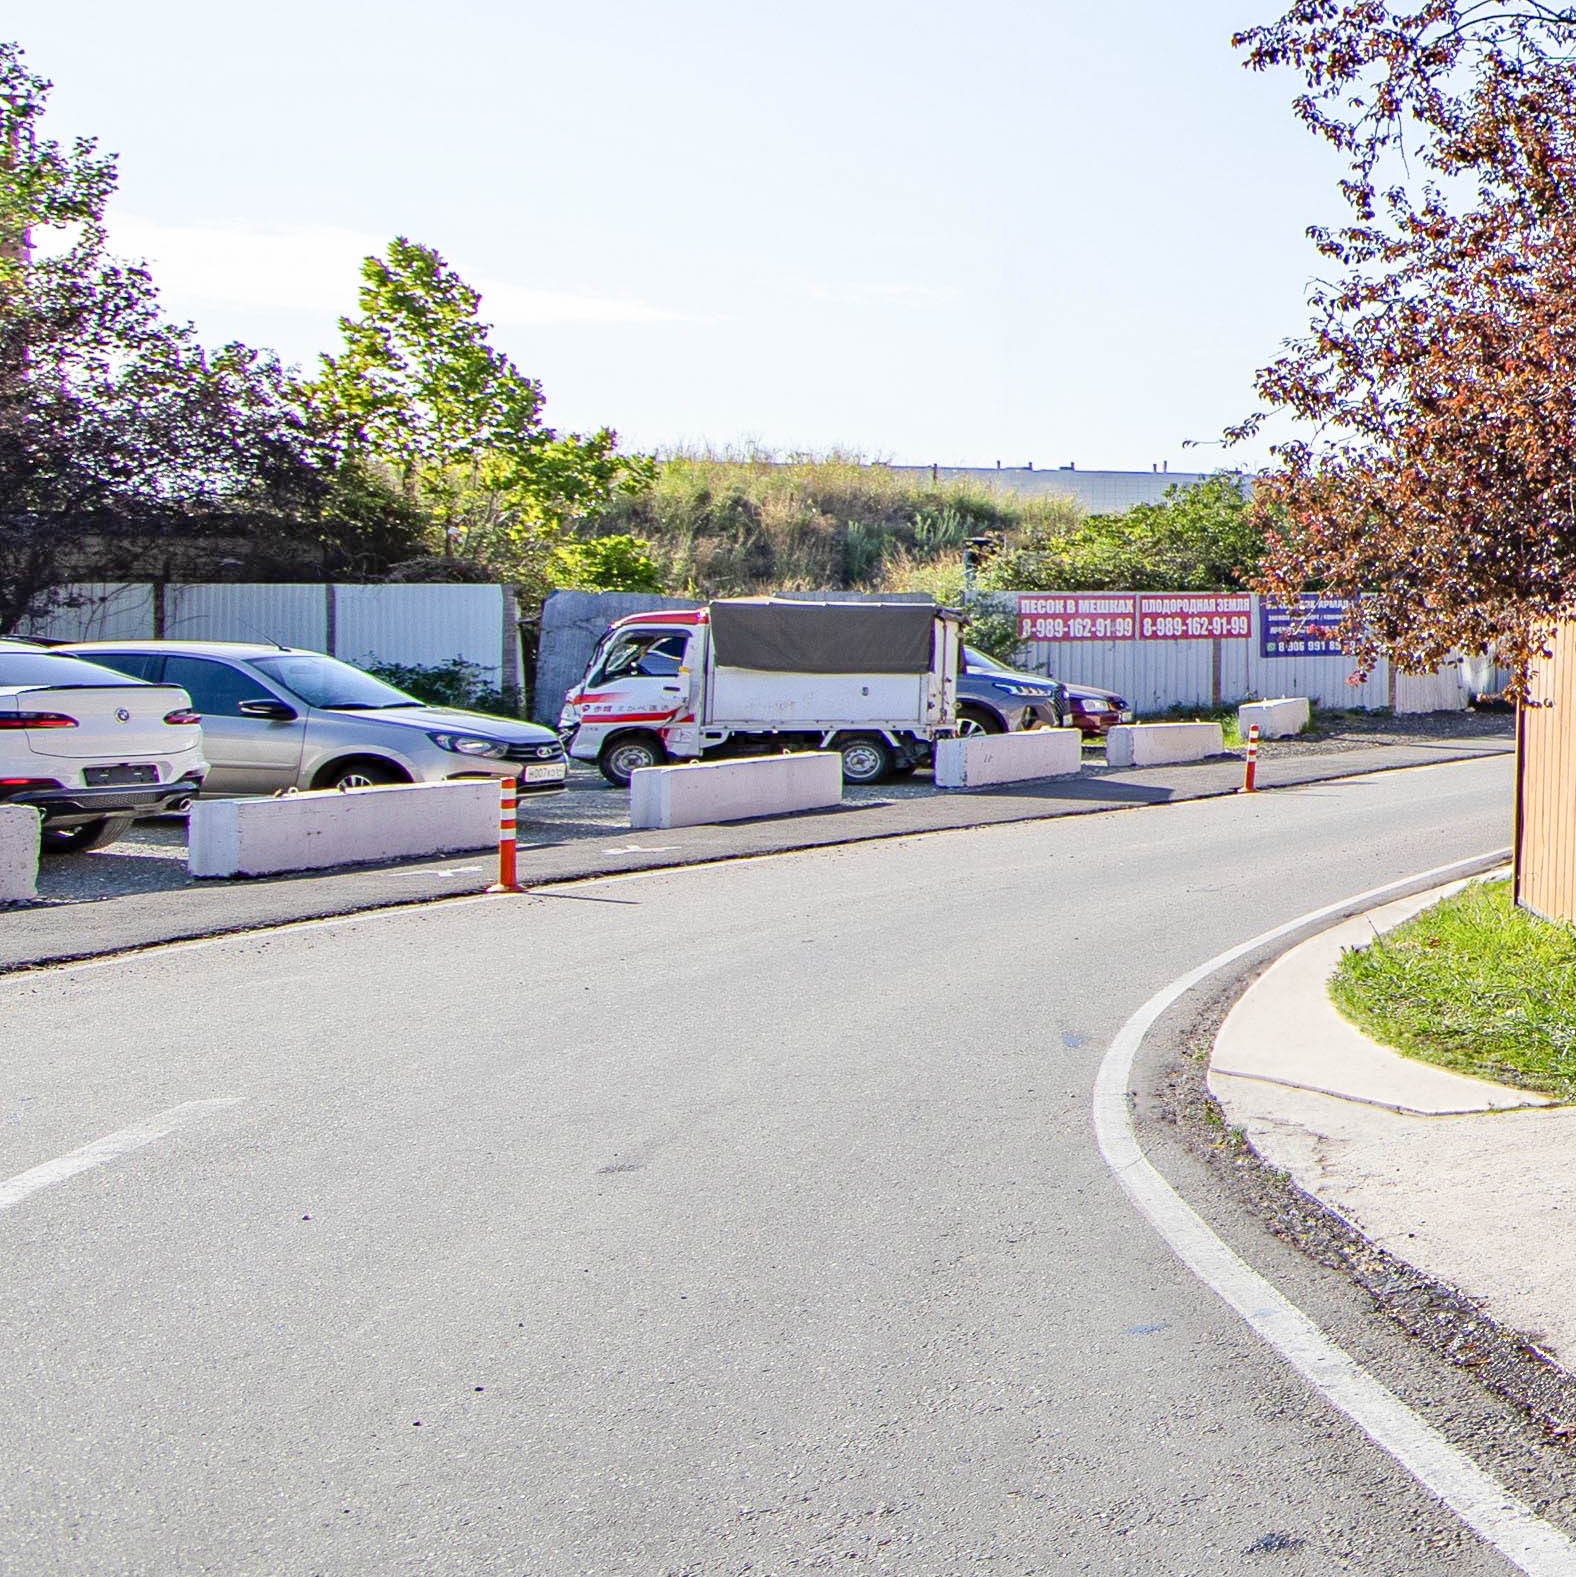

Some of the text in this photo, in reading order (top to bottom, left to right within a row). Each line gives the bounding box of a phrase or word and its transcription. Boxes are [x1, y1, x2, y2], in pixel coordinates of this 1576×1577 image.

[1021, 599, 1134, 614] ПЕСОК В МЕШКАХ
[1141, 598, 1216, 615] ПЛОДОРОДНАЯ
[1217, 598, 1250, 612] ЗЕМЛЯ
[1143, 616, 1248, 637] 8-989-162-91-99
